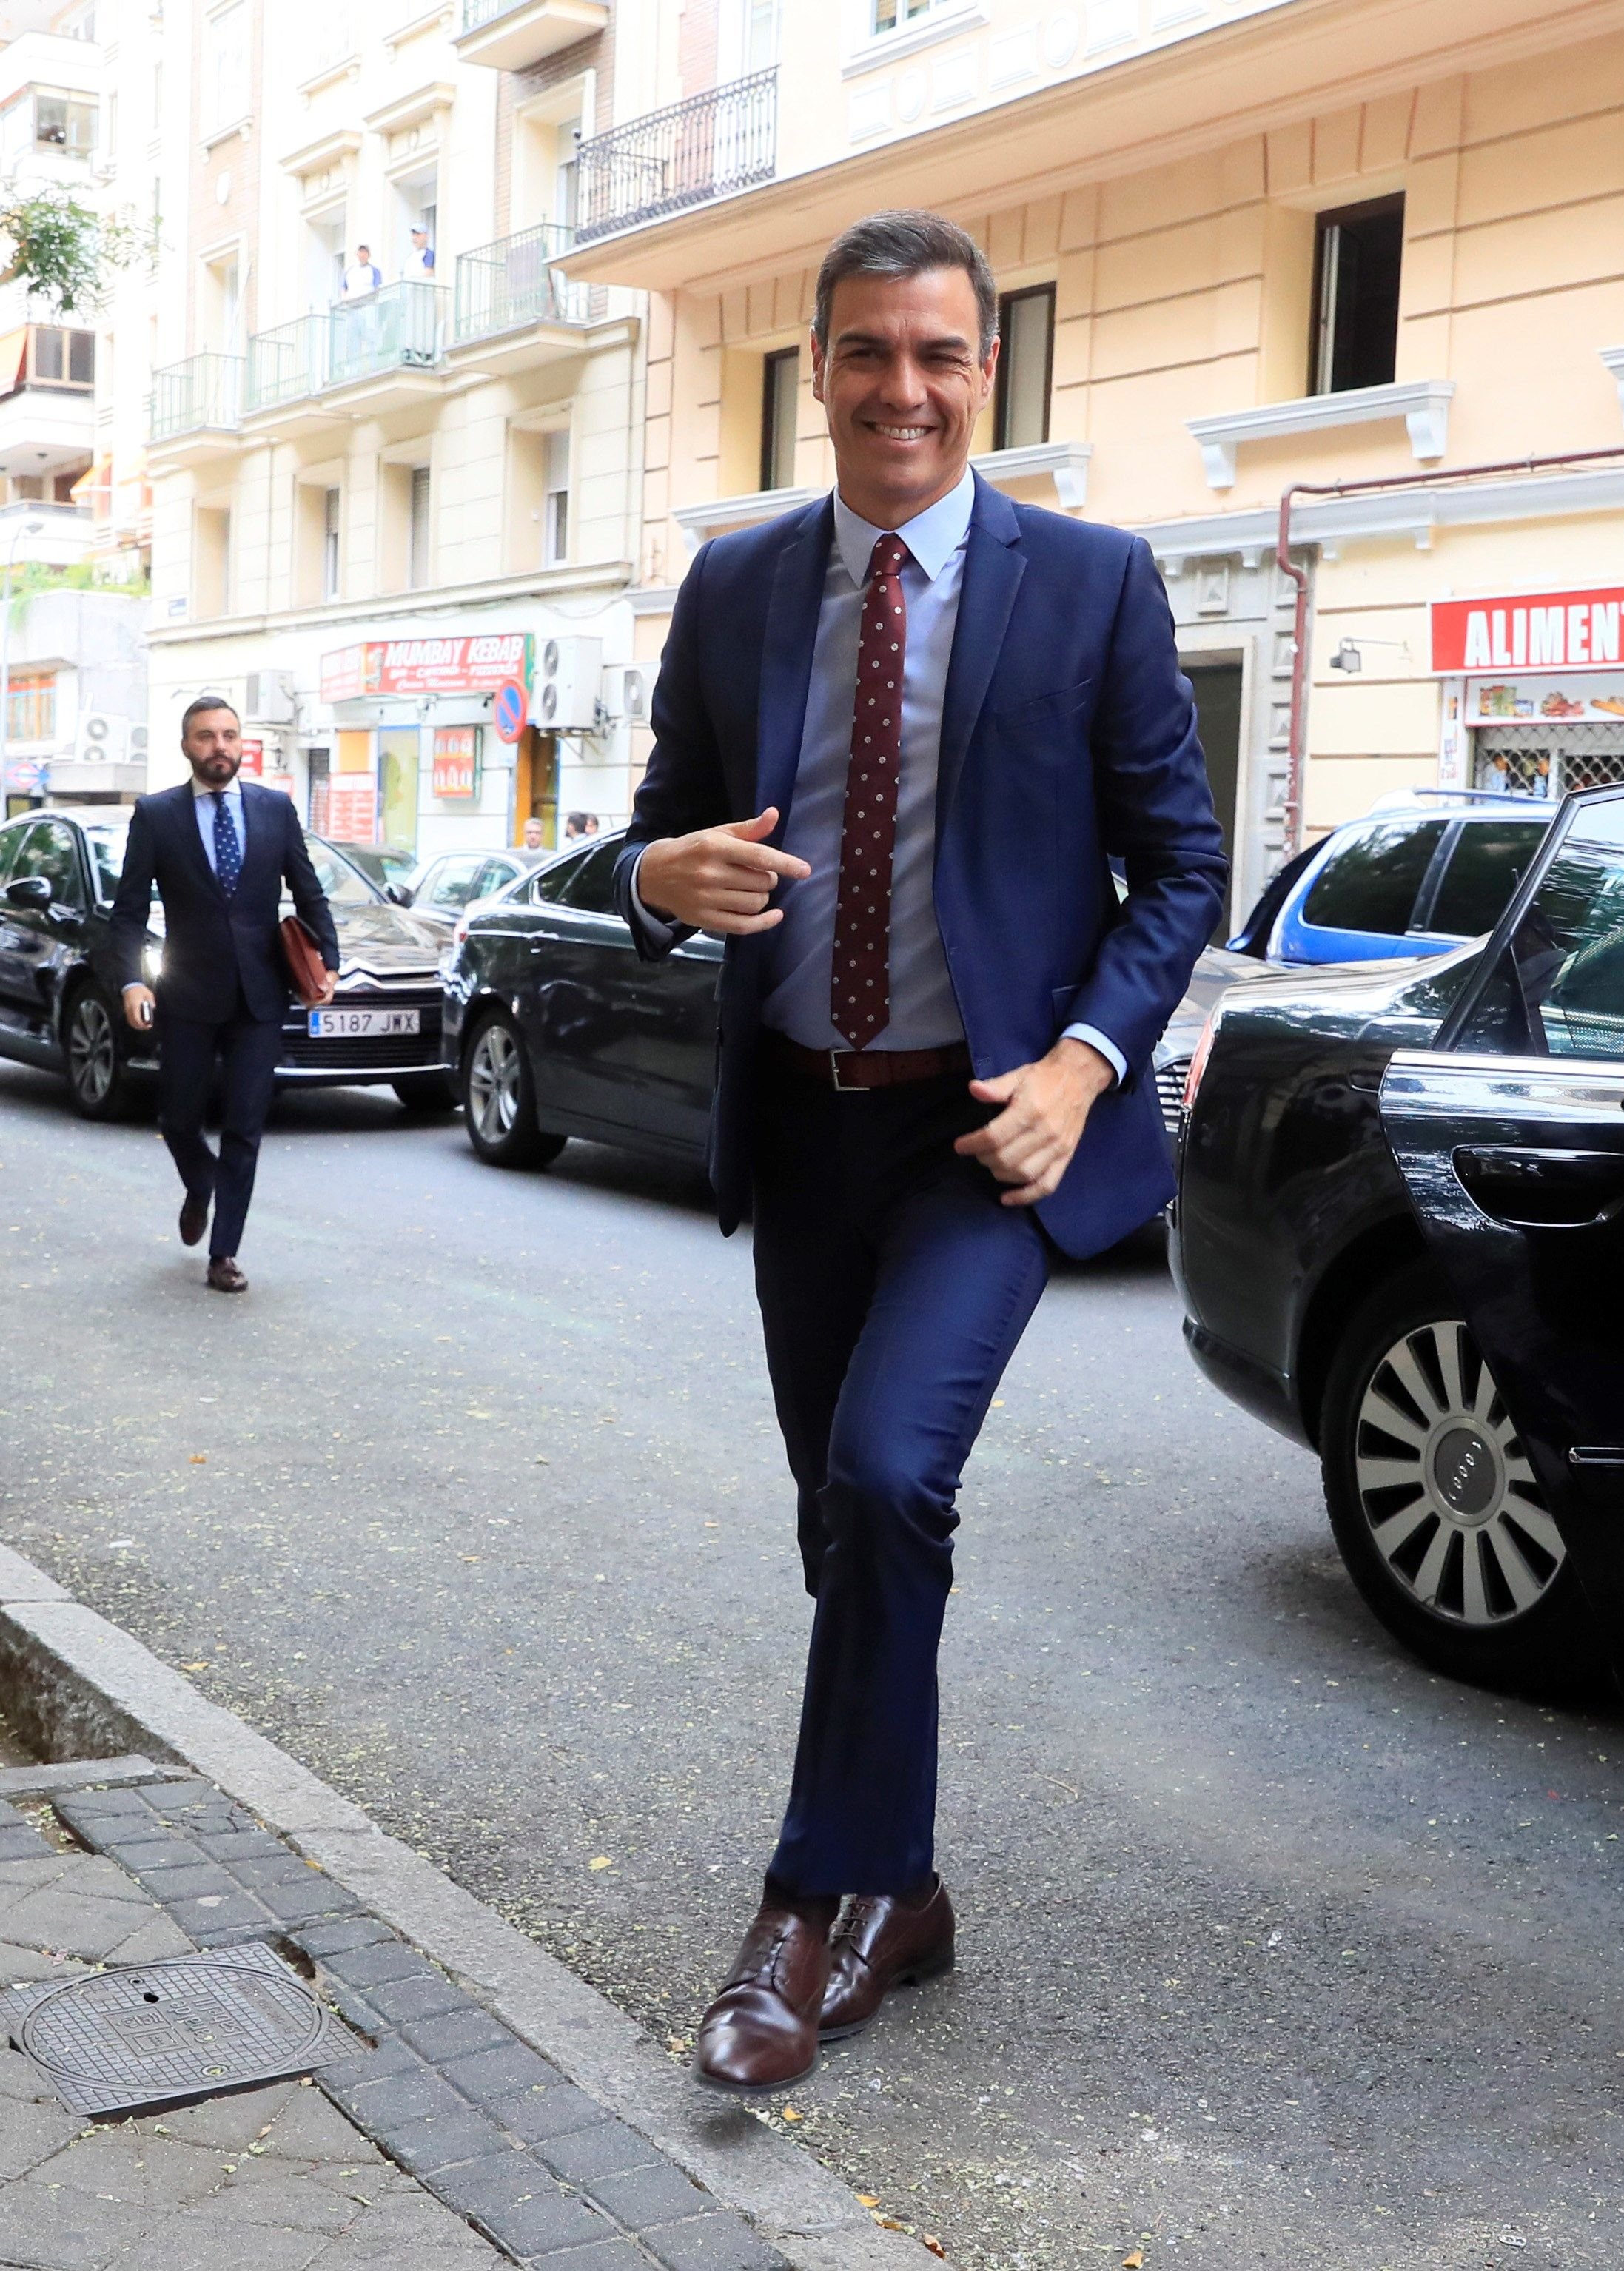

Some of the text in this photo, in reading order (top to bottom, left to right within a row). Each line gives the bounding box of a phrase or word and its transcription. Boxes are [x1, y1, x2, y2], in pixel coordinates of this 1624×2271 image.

[1463, 600, 1624, 668] ALIMEN
[384, 639, 466, 668] MUMBAY
[467, 635, 524, 664] KEBAB
[323, 1014, 372, 1033] 5187
[380, 1013, 415, 1032] JWX
[167, 2000, 217, 2044] Canal de
[197, 2006, 245, 2038] Isabel
